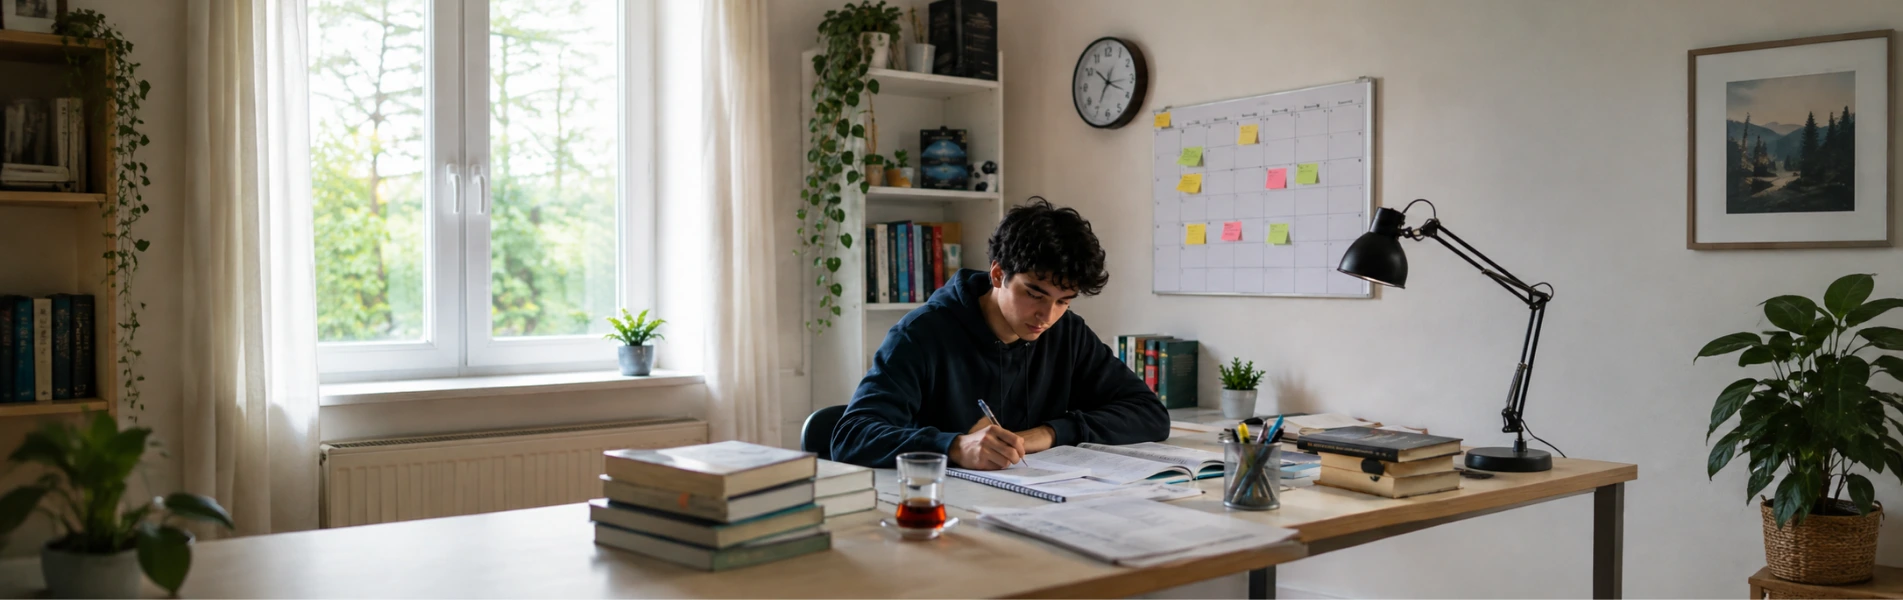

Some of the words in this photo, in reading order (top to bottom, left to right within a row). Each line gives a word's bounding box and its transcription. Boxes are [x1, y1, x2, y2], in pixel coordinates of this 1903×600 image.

[1104, 46, 1112, 57] 12
[1118, 47, 1122, 58] 1
[1093, 54, 1100, 64] 11
[1125, 59, 1131, 68] 2
[1117, 103, 1122, 113] 5
